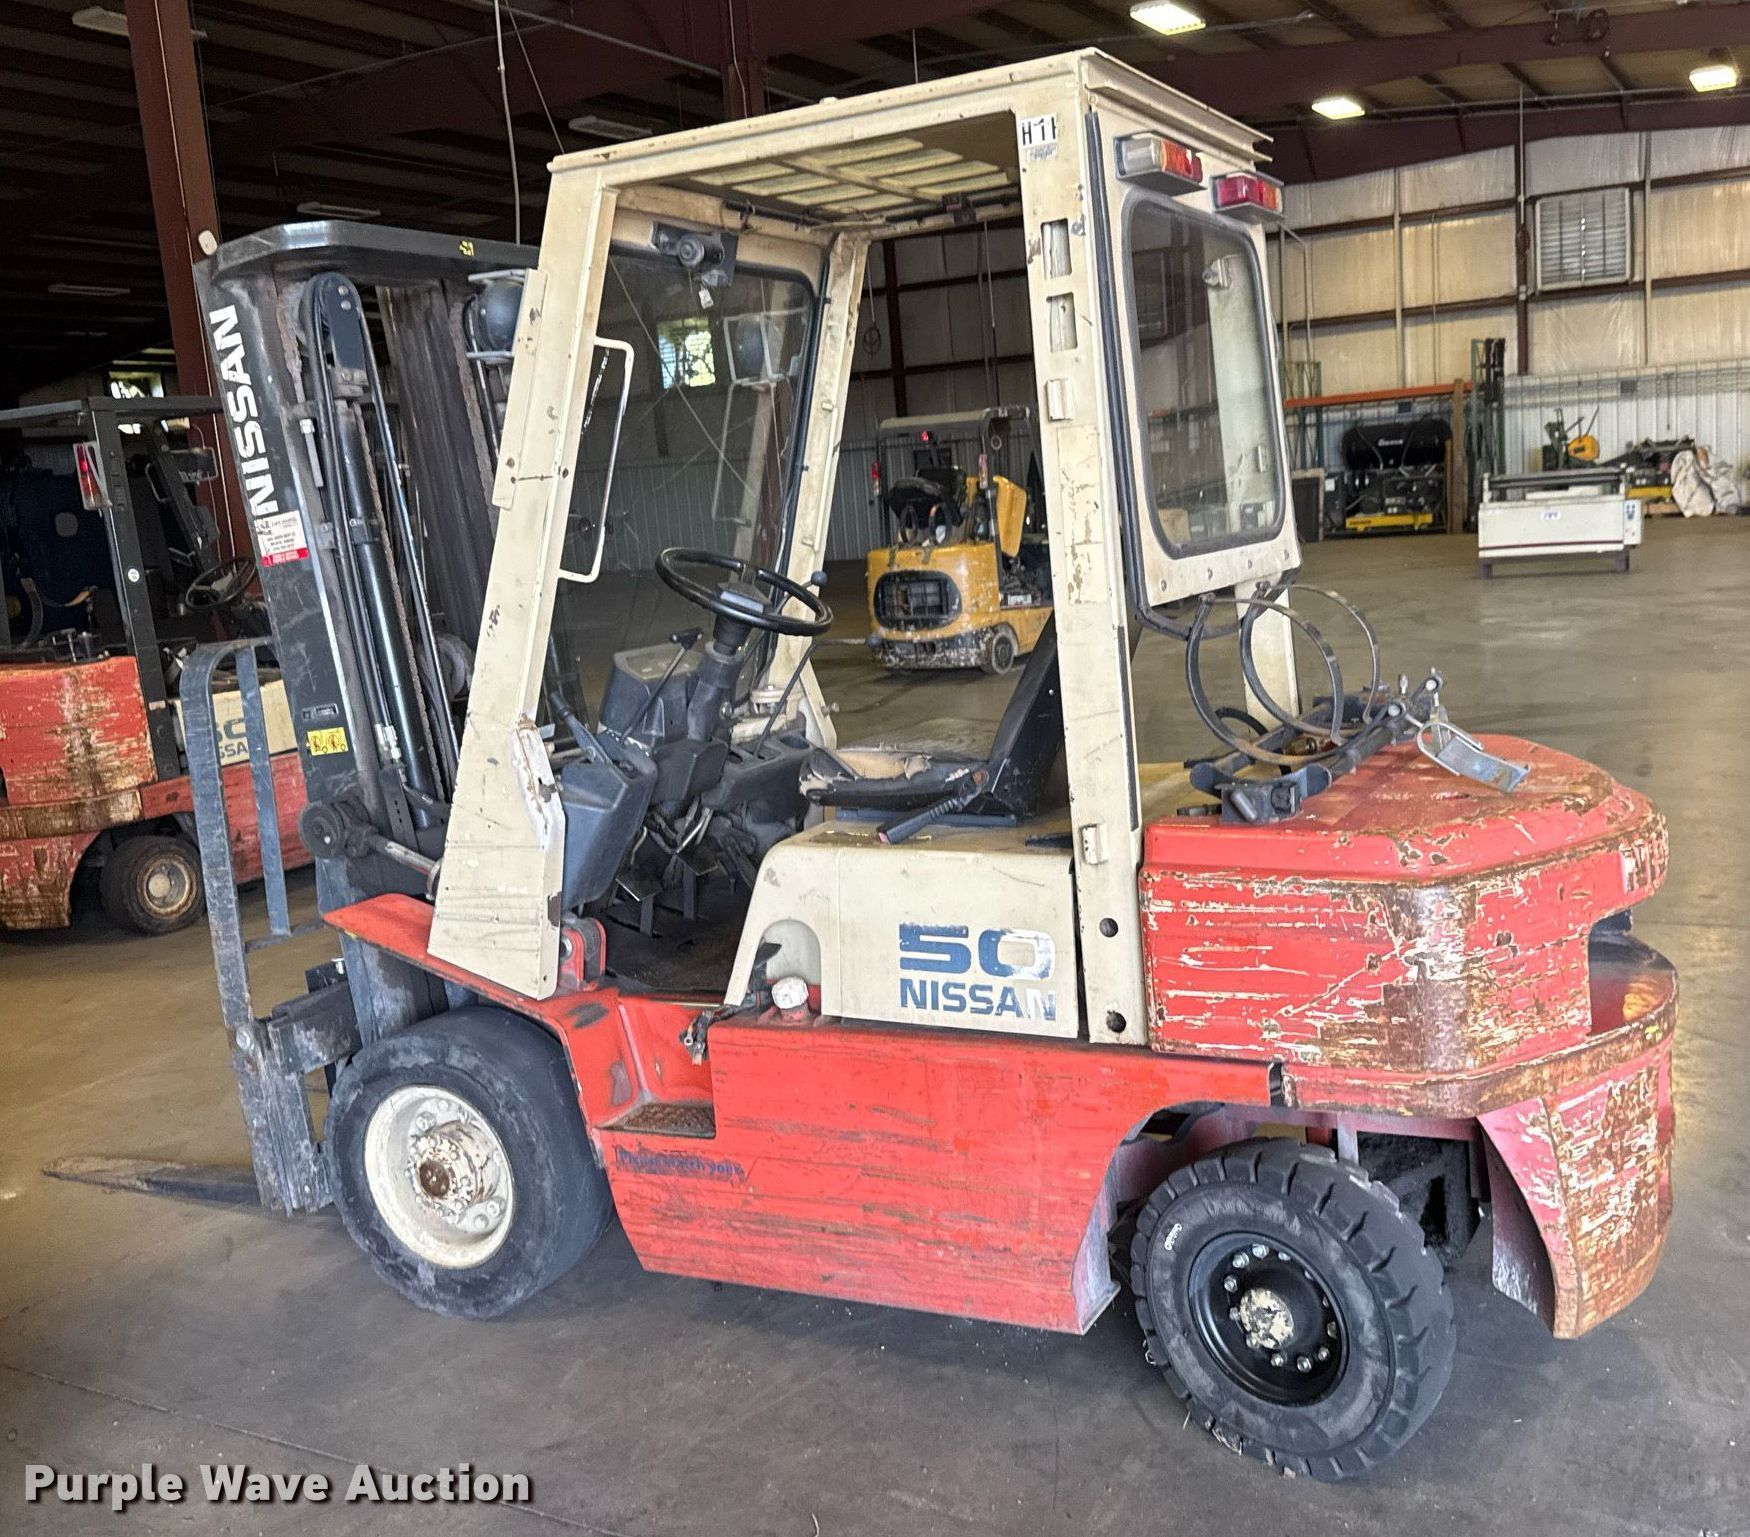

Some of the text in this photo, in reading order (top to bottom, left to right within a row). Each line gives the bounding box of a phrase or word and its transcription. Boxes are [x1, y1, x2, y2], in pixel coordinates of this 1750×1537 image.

[208, 304, 279, 517] NISSAN
[899, 923, 1056, 981] 50
[899, 977, 1057, 1022] NISSAN
